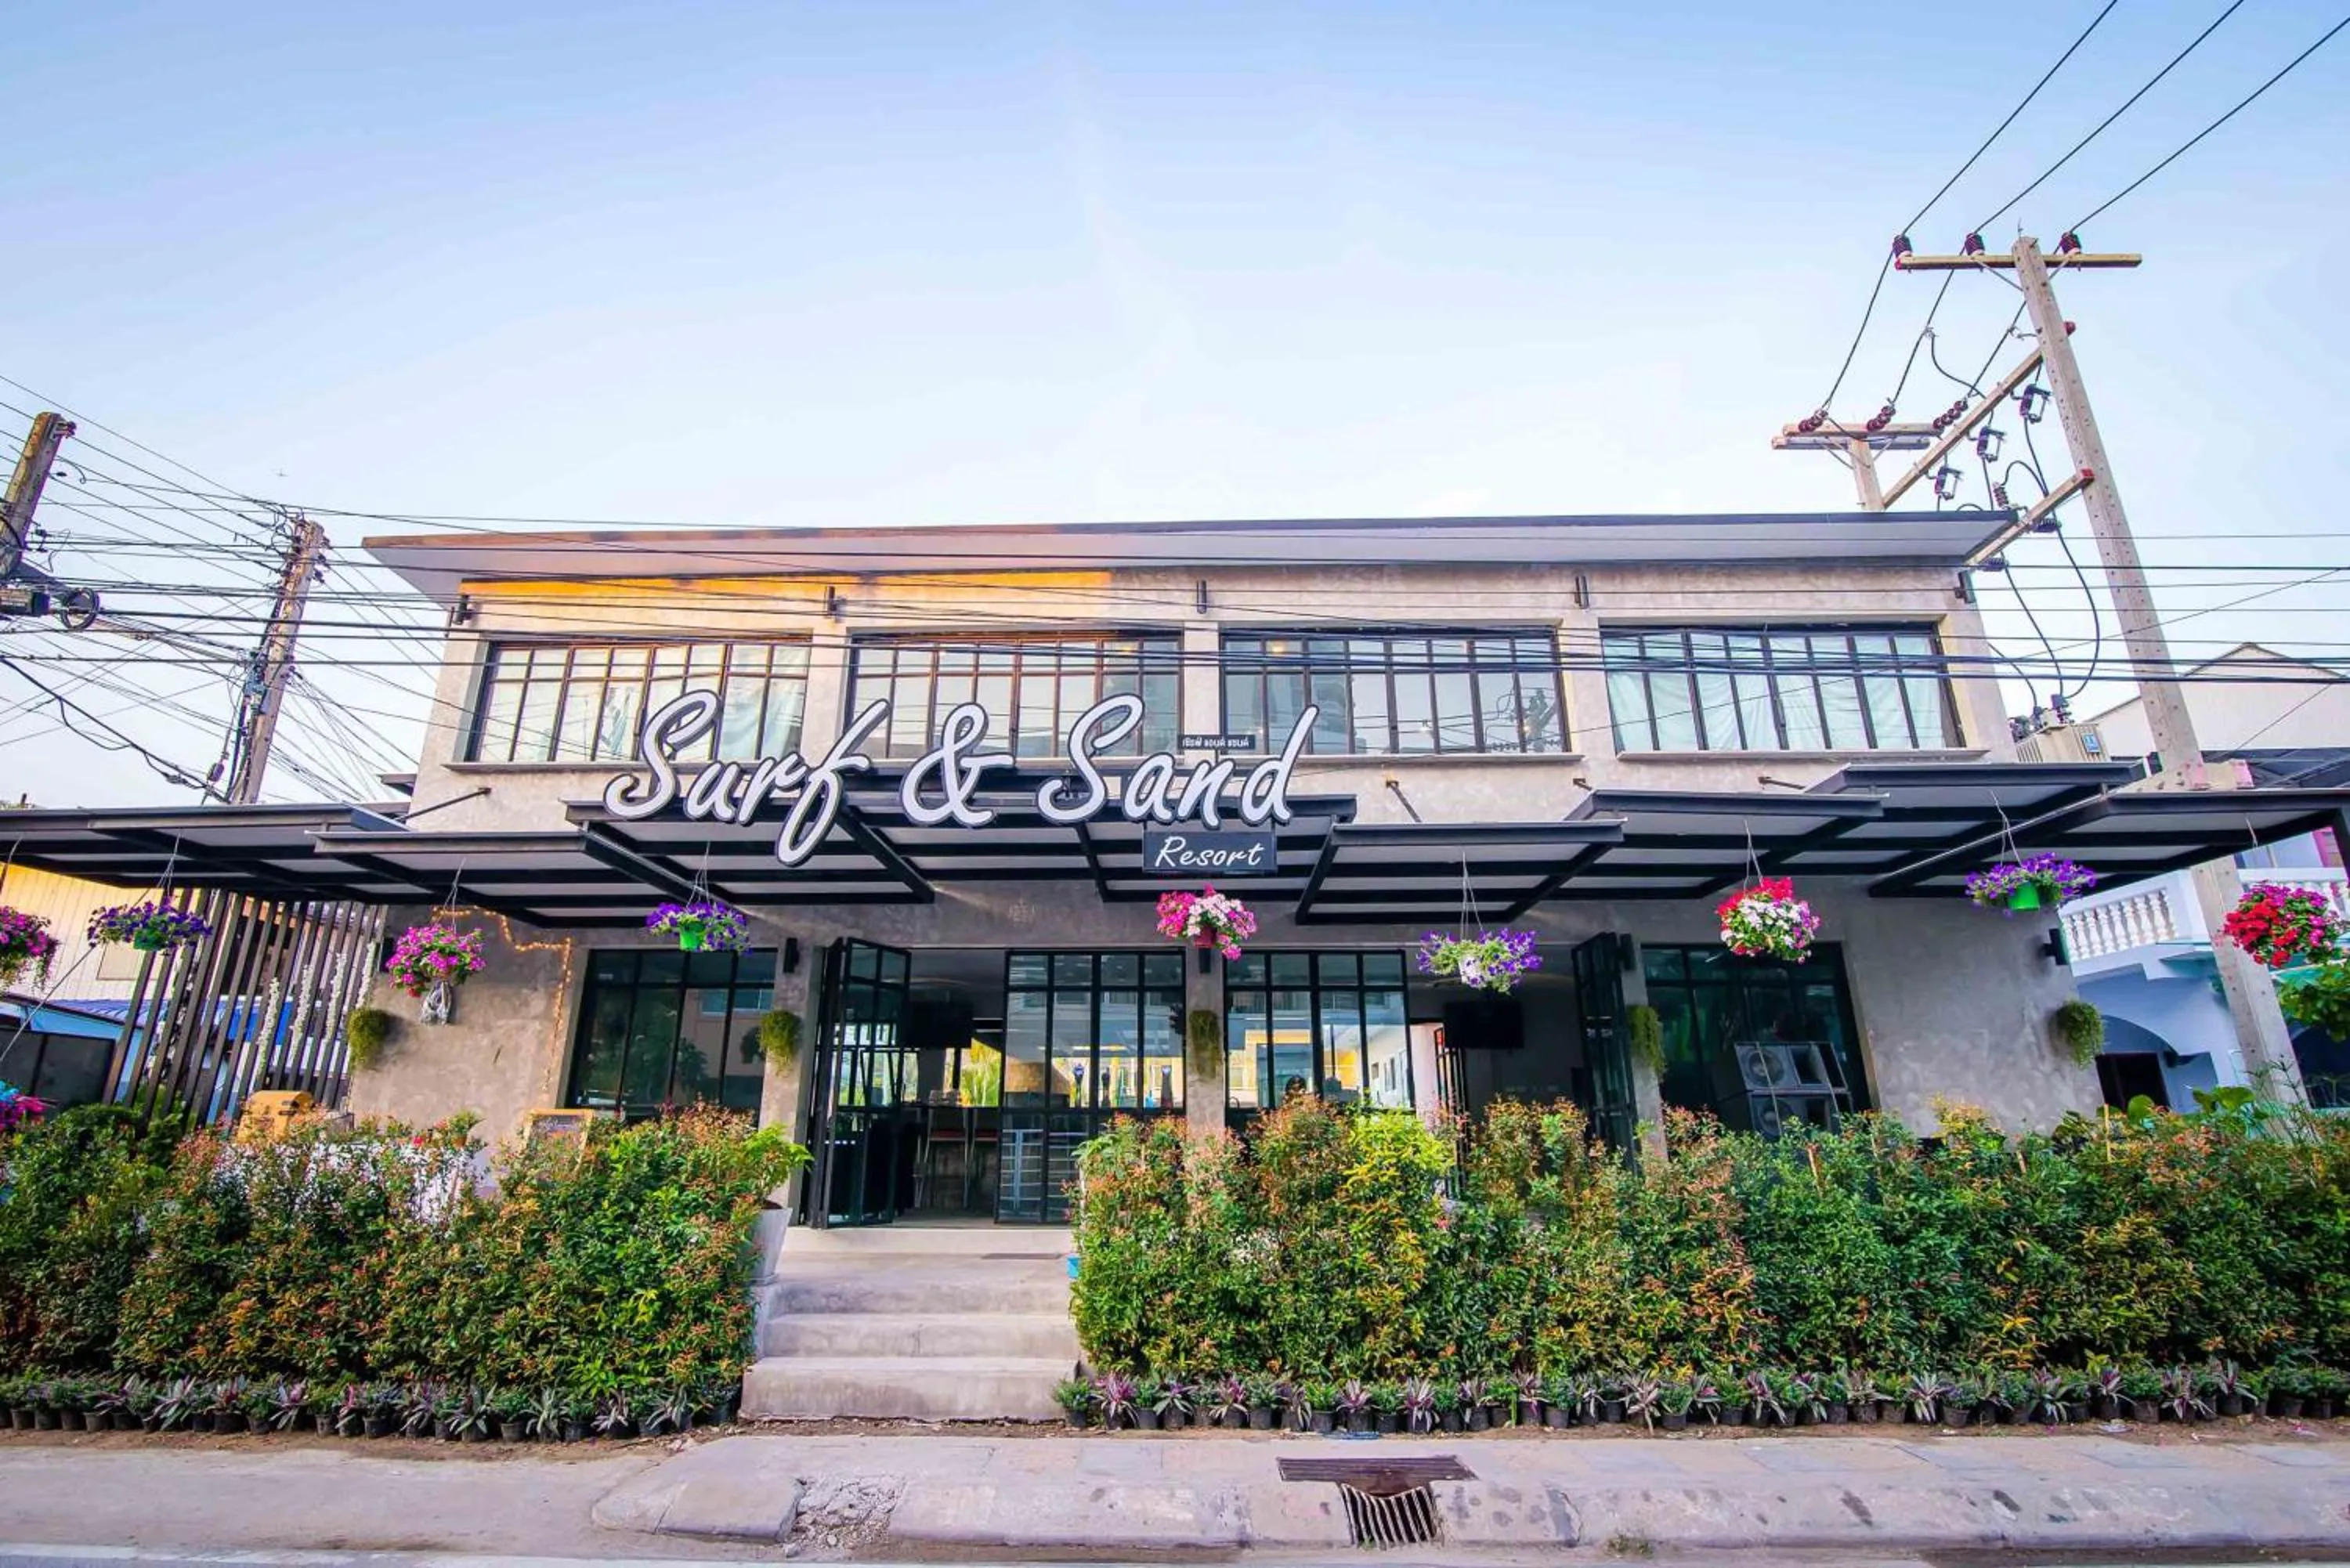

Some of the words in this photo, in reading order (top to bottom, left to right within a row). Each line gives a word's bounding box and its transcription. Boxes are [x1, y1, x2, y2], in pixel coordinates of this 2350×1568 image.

[603, 689, 891, 866] Surf
[902, 703, 1014, 828] &
[1037, 693, 1319, 829] Sand
[1155, 836, 1265, 867] Resort
